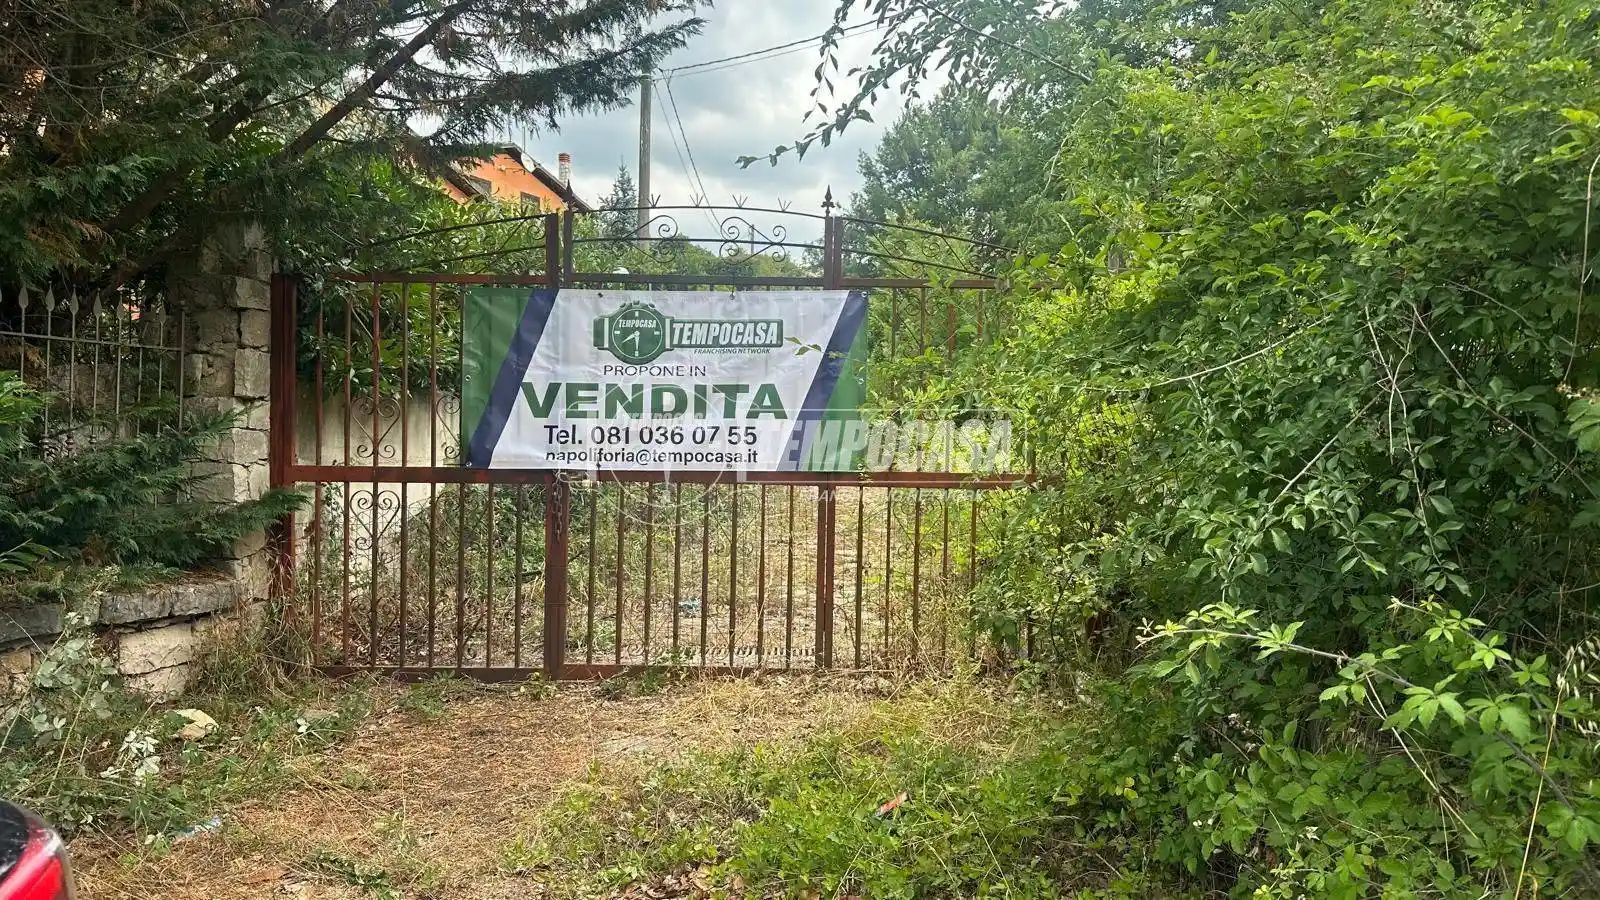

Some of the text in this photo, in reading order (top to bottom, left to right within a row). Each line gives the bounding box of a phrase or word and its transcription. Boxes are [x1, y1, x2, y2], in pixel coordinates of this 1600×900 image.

[618, 319, 657, 328] TEMPOCASA
[673, 322, 779, 345] TEMPOCASA
[603, 365, 707, 377] PROPONE IN
[520, 382, 788, 419] VENDITA
[543, 424, 757, 446] Tel. 081 036 07 55
[545, 447, 758, 466] napoliforia@tempocasa.it
